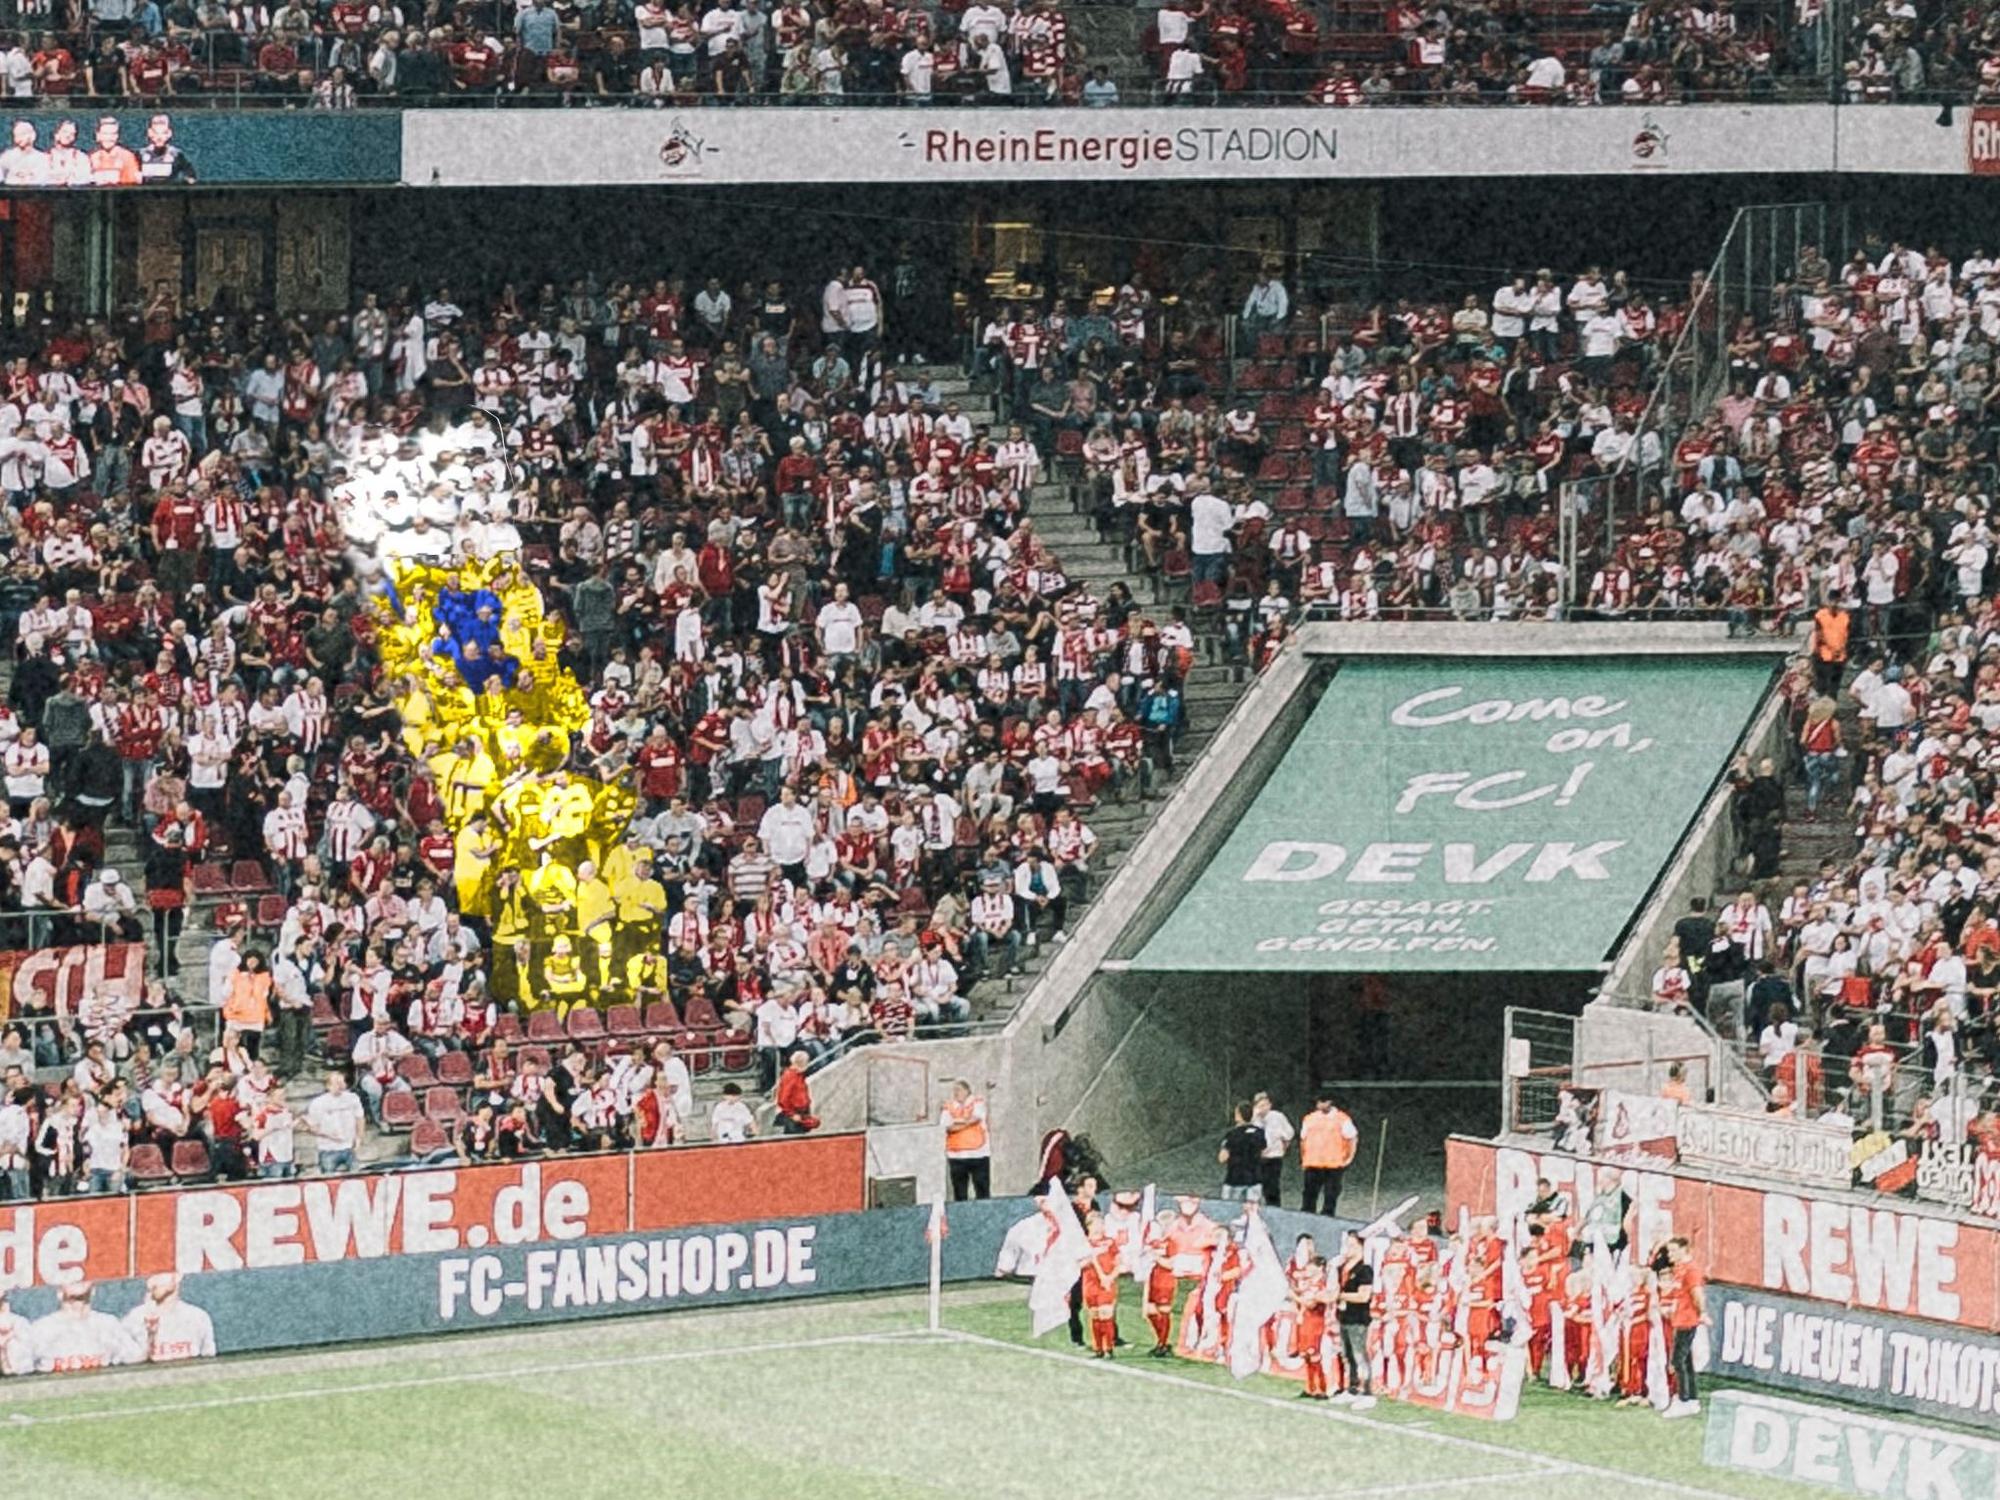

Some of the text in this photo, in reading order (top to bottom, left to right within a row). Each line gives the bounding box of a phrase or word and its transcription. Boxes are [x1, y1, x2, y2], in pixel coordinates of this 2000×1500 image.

[925, 127, 1337, 169] RheinEnergieSTADION
[1391, 685, 1627, 727] Come
[1546, 722, 1654, 753] on,
[1395, 761, 1595, 813] FC!
[1242, 840, 1628, 884] DEVK
[1317, 899, 1493, 915] GESAGT.
[1317, 917, 1465, 934] GETAN.
[176, 1162, 590, 1273] REWE.de
[438, 1225, 816, 1320] FC-FANSHOP.DE
[1763, 1191, 1961, 1321] REWE
[1722, 1301, 1777, 1370] DIE
[1780, 1311, 1884, 1390] NEUEN
[1730, 1404, 1967, 1500] DEVK
